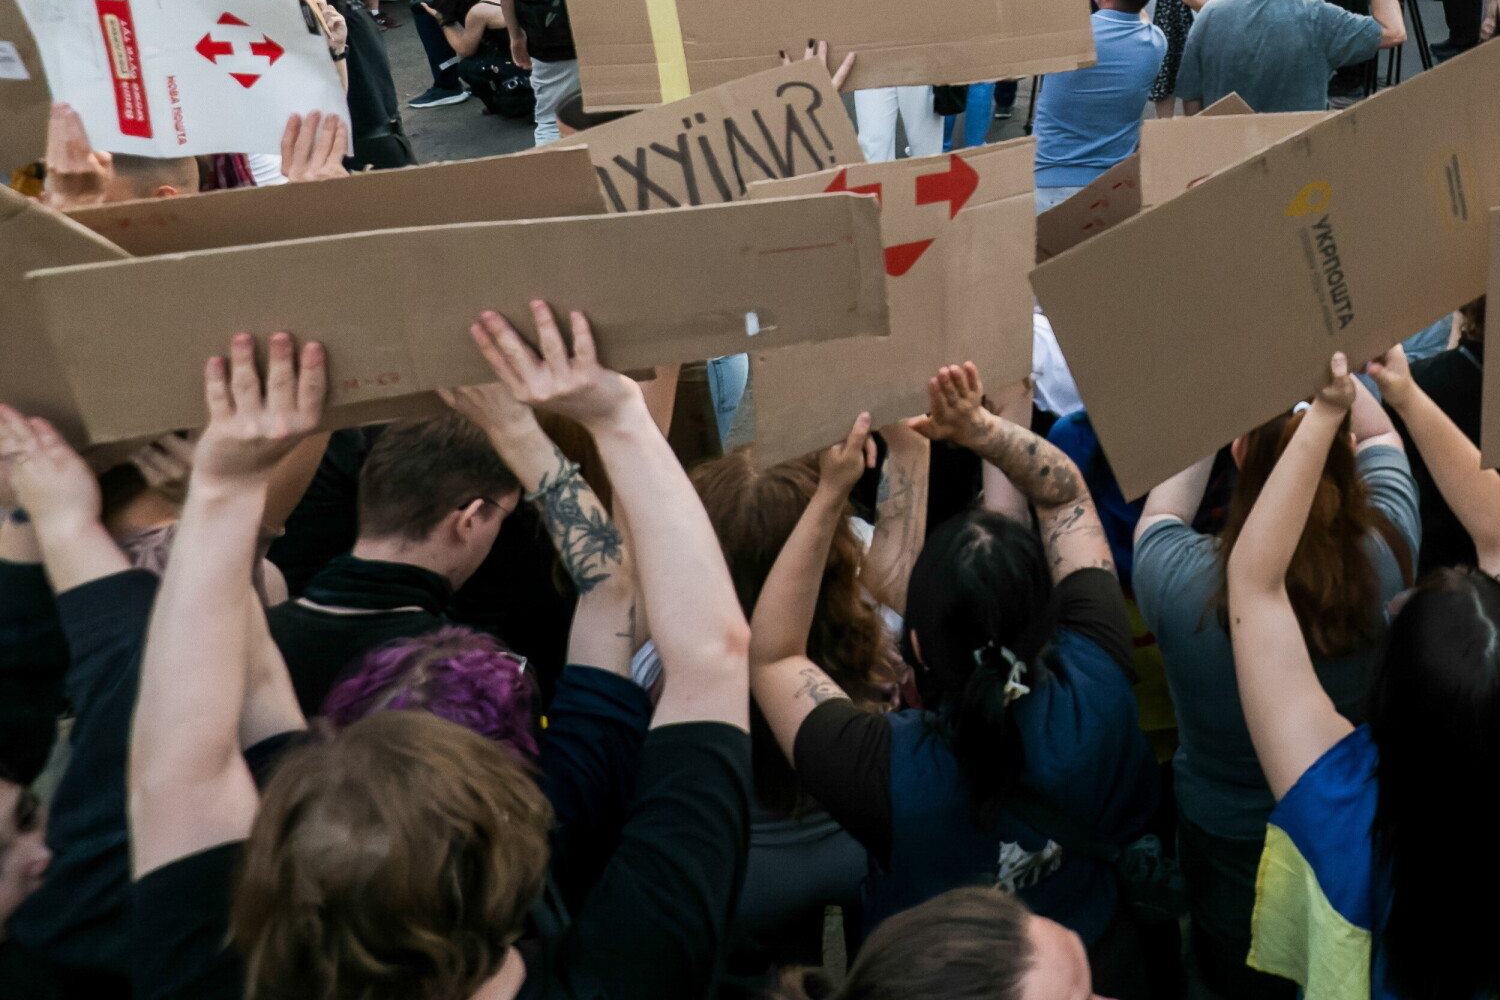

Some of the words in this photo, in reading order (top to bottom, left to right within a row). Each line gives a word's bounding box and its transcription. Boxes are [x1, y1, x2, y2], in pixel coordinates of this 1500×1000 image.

[166, 74, 181, 108] НОВА
[171, 109, 188, 148] ПОШТА
[1311, 213, 1355, 331] УКРПОШТА
